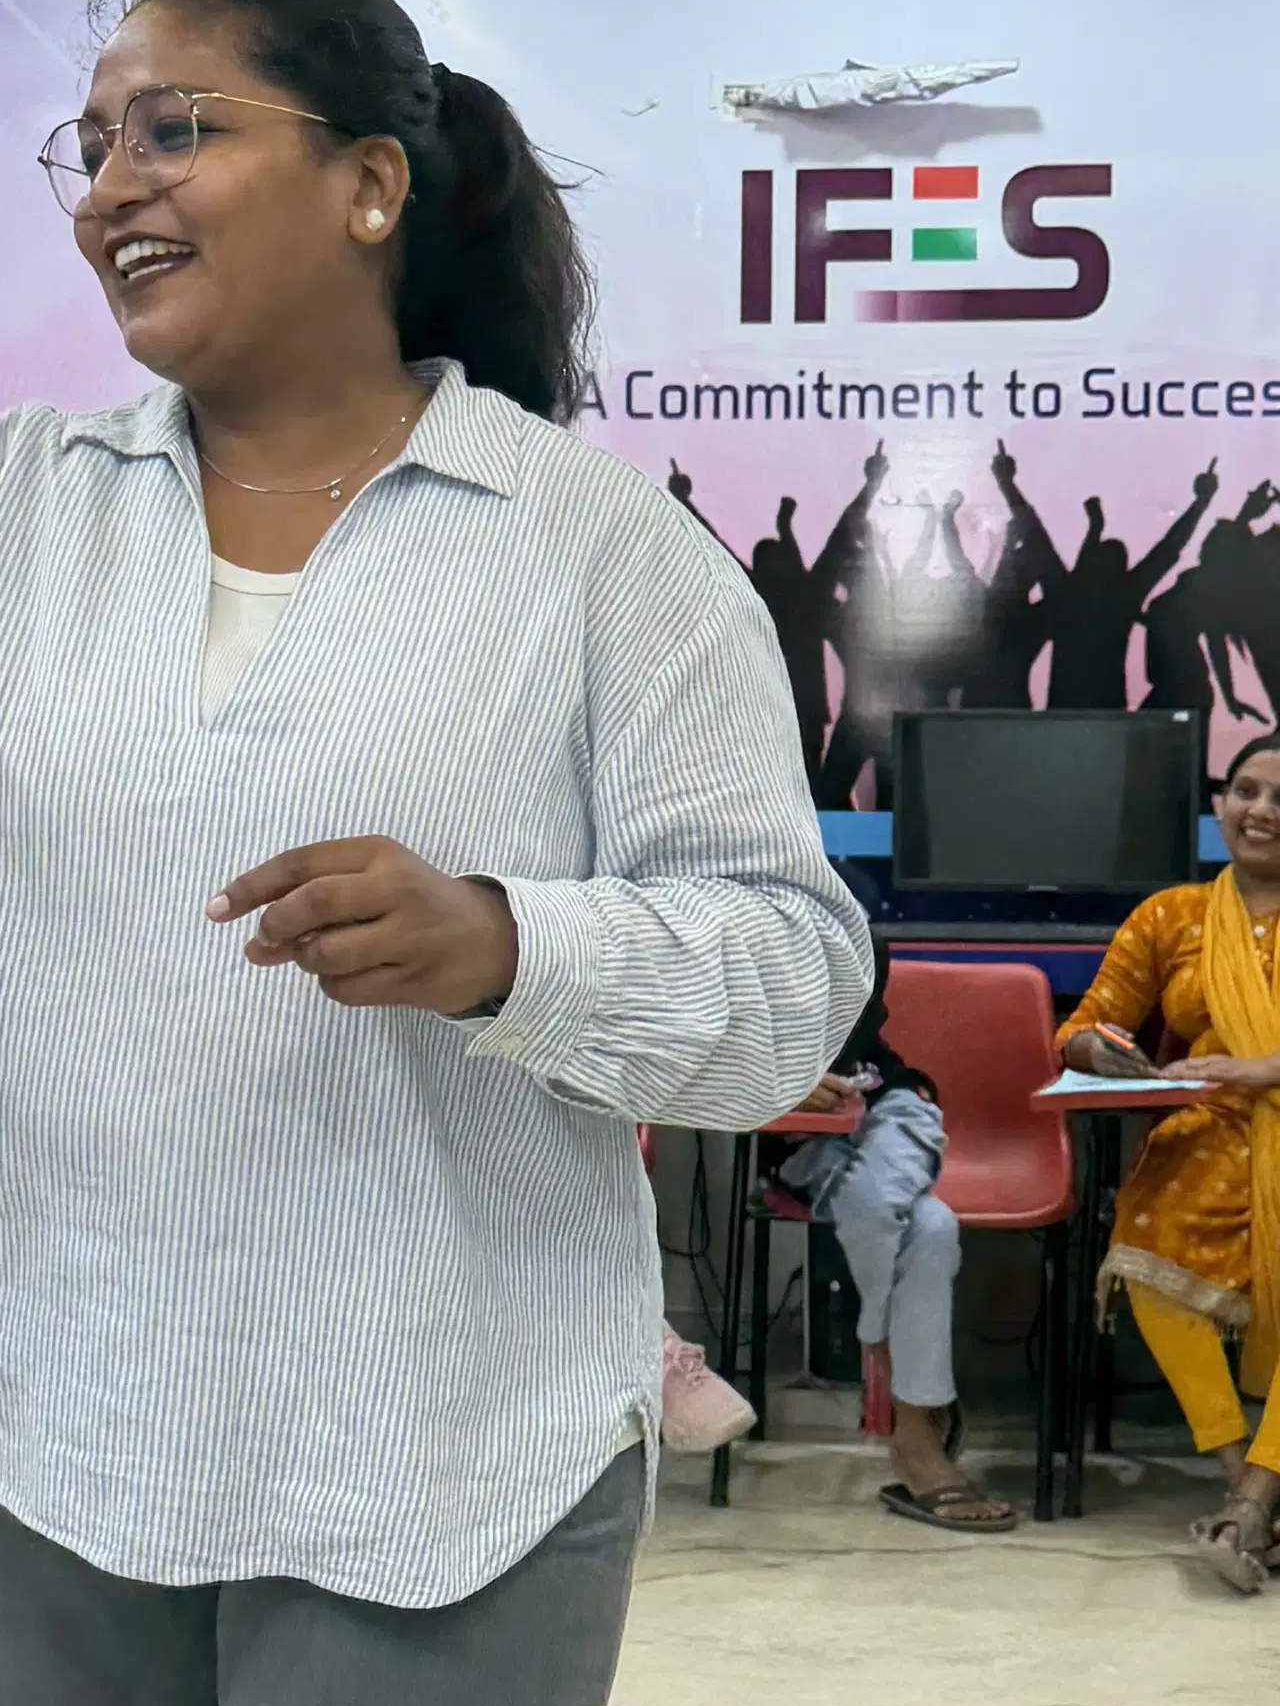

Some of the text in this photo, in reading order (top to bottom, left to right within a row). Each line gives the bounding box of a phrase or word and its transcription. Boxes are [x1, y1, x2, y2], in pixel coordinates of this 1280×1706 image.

[740, 163, 1113, 325] IFES
[575, 370, 608, 421] A
[625, 368, 984, 421] Commitment
[1004, 368, 1063, 420] to
